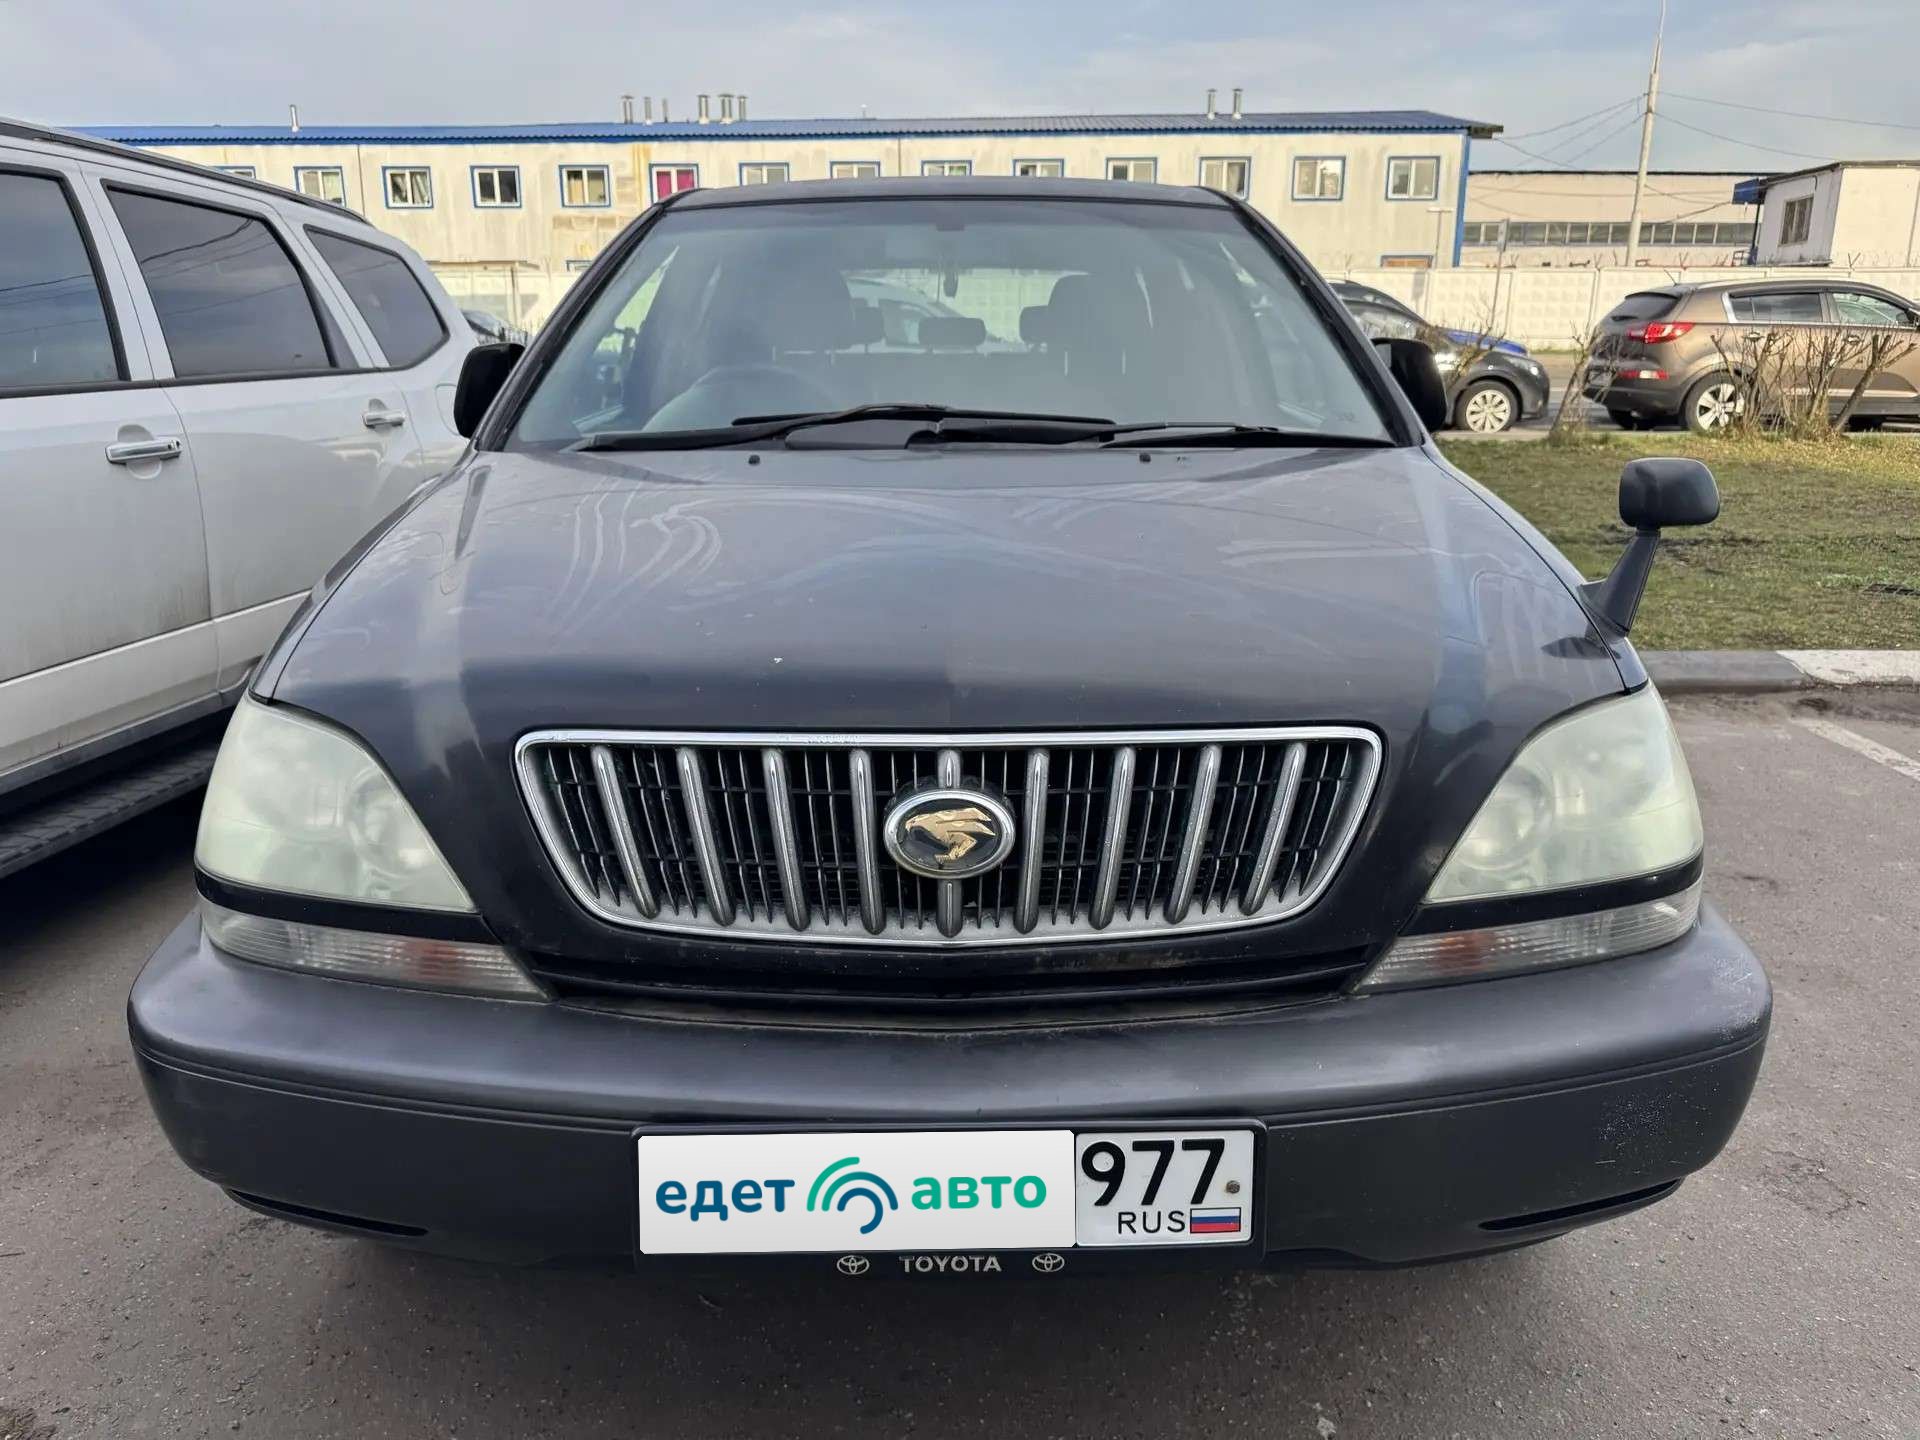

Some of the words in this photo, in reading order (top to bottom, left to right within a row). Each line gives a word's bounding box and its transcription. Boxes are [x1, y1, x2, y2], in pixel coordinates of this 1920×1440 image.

[1081, 1139, 1225, 1206] 977
[1117, 1210, 1186, 1234] RUS
[901, 1256, 1002, 1273] TOYOTA
